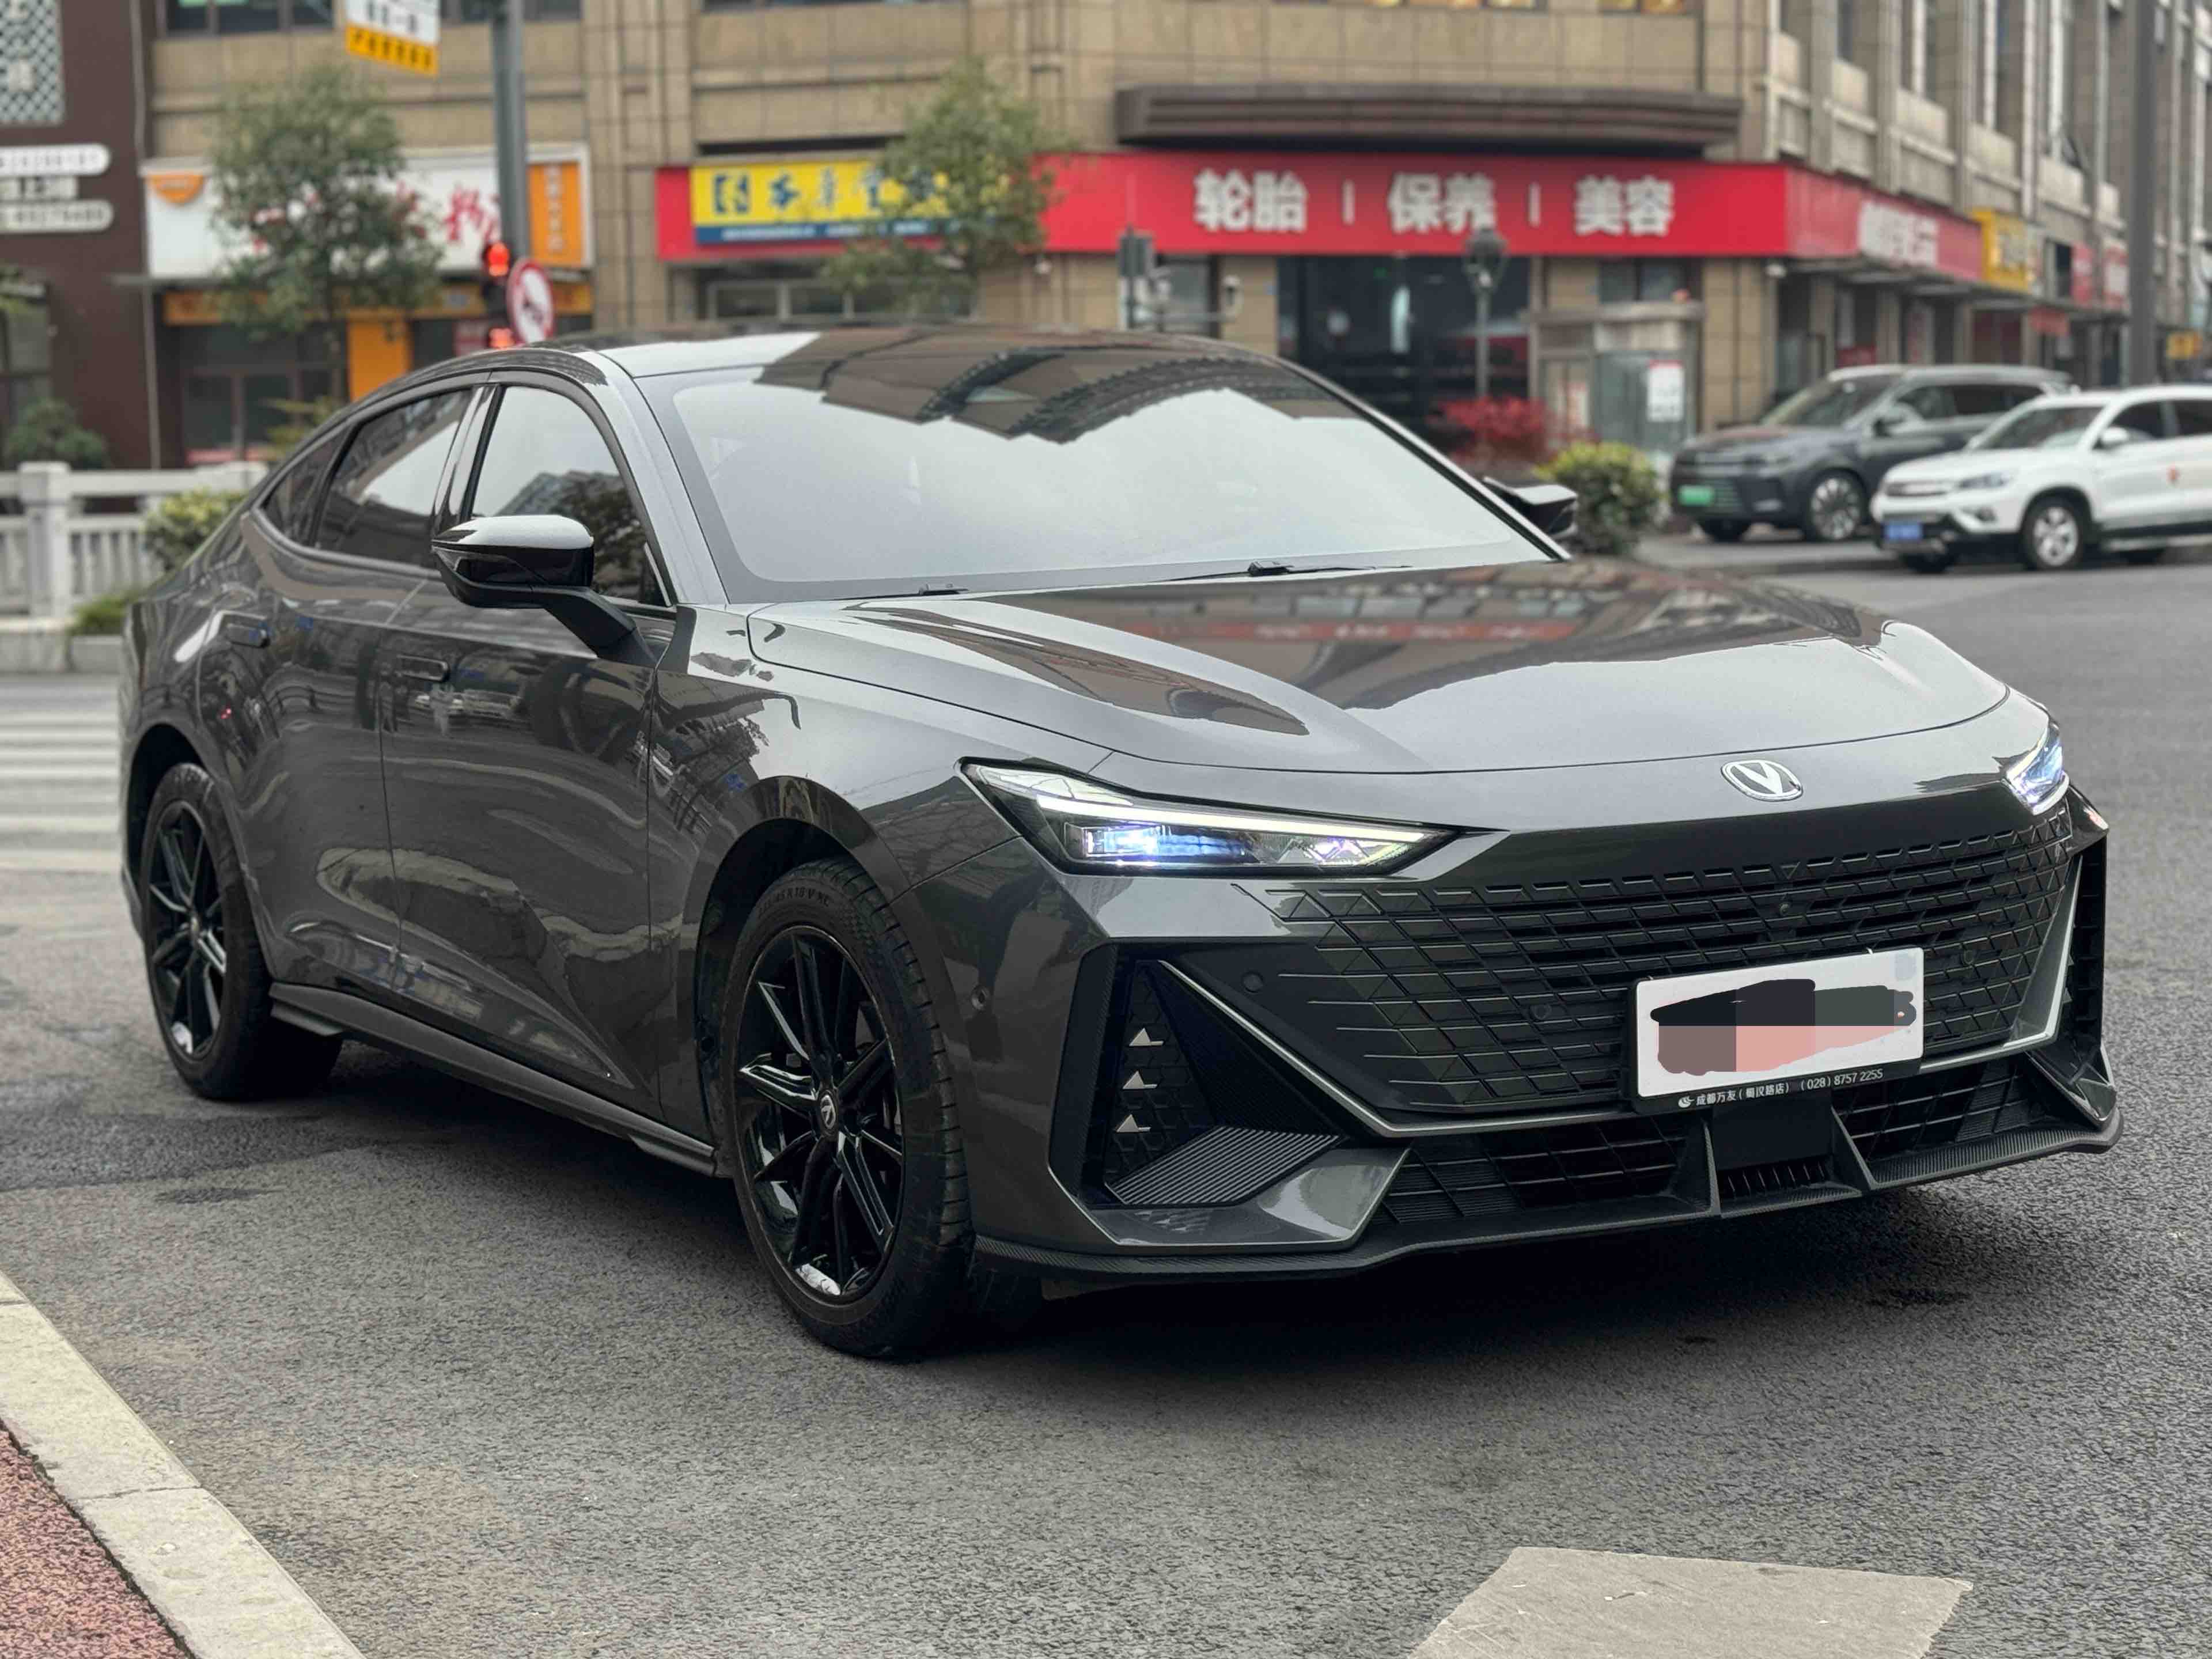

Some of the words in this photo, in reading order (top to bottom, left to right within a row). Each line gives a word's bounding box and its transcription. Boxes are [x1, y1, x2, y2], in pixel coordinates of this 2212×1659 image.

[1193, 168, 1309, 233] 轮胎
[1388, 171, 1496, 233] 保养
[1575, 174, 1675, 236] 美容
[1834, 1073, 1858, 1086] 8757
[1859, 1069, 1884, 1082] 2255
